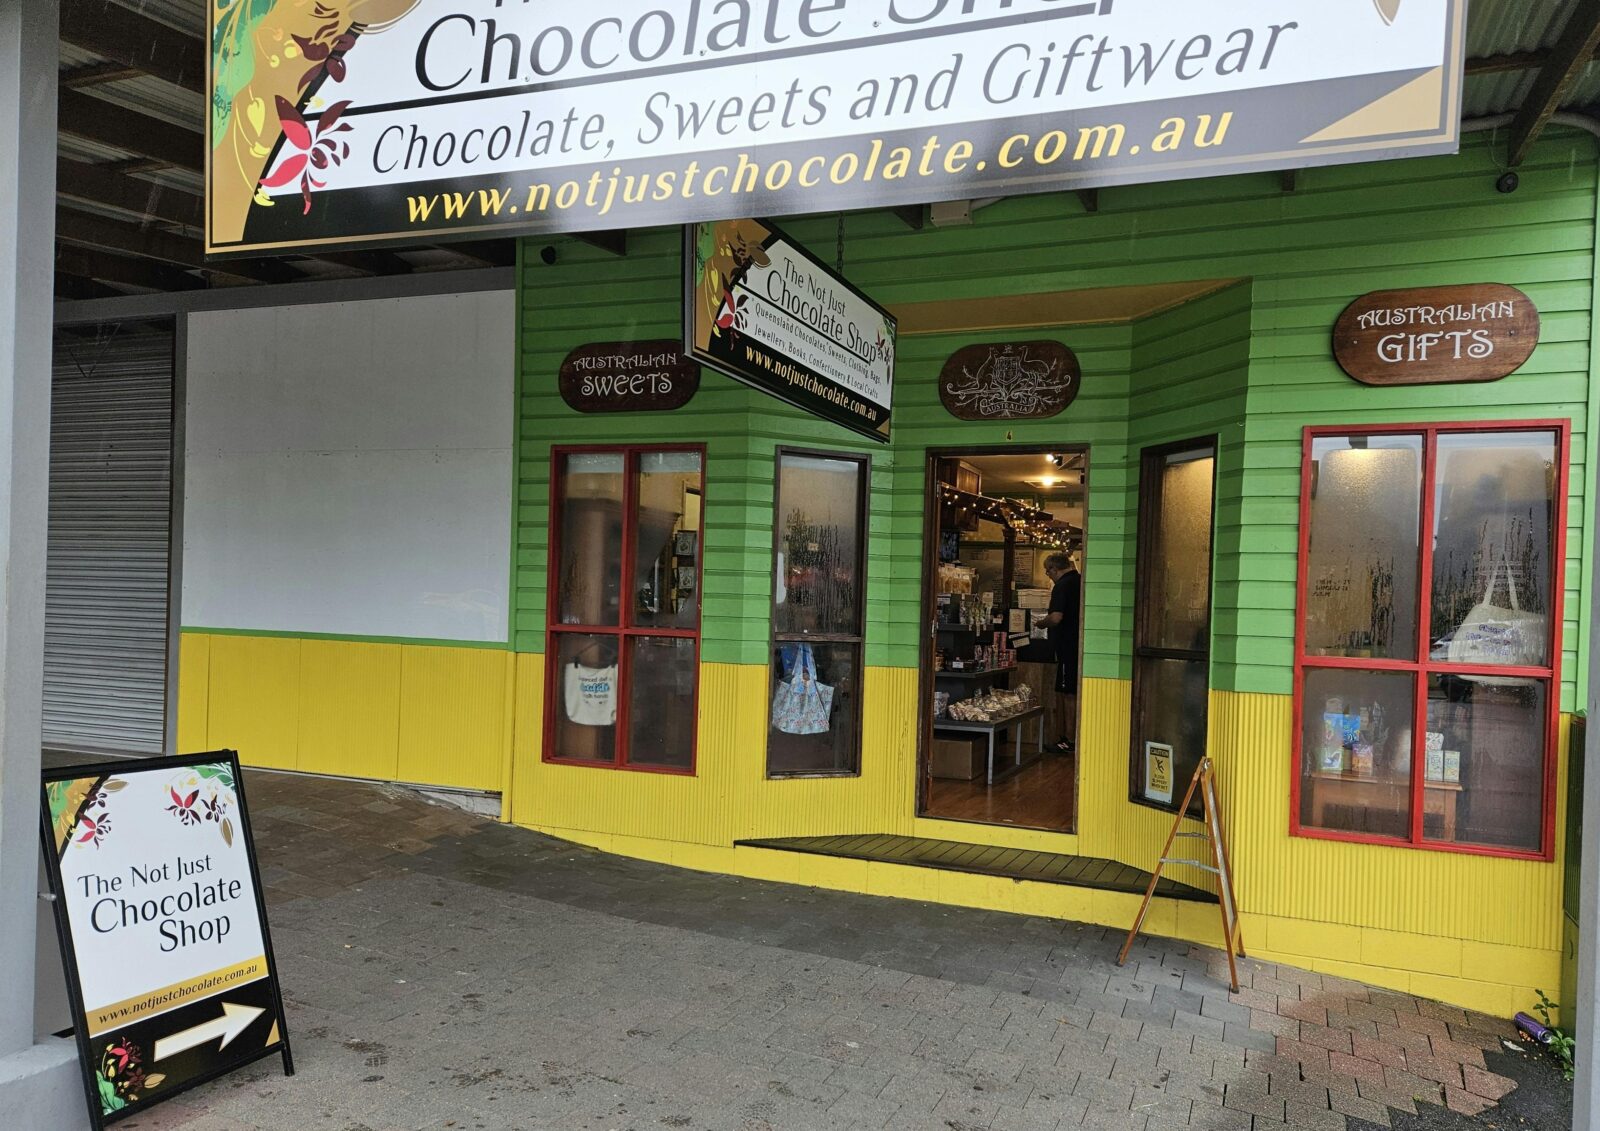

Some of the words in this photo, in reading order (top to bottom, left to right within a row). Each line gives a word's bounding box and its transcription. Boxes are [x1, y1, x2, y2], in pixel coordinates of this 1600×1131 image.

[415, 0, 849, 92] Chocolate
[372, 107, 615, 174] Chocolate,
[637, 78, 832, 144] Sweets
[849, 53, 963, 121] and
[982, 20, 1298, 104] Giftwear
[406, 111, 1233, 223] www.notjustchocolate.com.au
[783, 257, 804, 288] The
[807, 273, 826, 304] Not
[827, 290, 846, 317] Just
[1356, 301, 1514, 329] AUSTRALIAN
[755, 303, 794, 334] Queensland
[794, 325, 827, 354] Chocolates,
[767, 269, 843, 341] Chocolate
[847, 321, 877, 366] Shop
[573, 352, 677, 371] AUSTRALIAN
[754, 324, 787, 351] Jewellery,
[788, 342, 808, 363] Books,
[808, 354, 846, 385] Confectionery
[846, 374, 851, 383] &
[851, 376, 864, 390] Local
[864, 384, 878, 399] Crafts
[1377, 329, 1494, 363] GIFTS
[581, 371, 673, 396] SWEETS
[746, 345, 877, 421] www.notjustchocolate.com.au
[986, 402, 1028, 413] AUSTRALIA
[77, 873, 123, 898] The
[131, 863, 170, 888] Not
[178, 854, 213, 881] Just
[90, 877, 242, 933] Chocolate
[159, 914, 231, 952] Shop
[98, 963, 258, 1024] www.notjustchocolate.com.au
